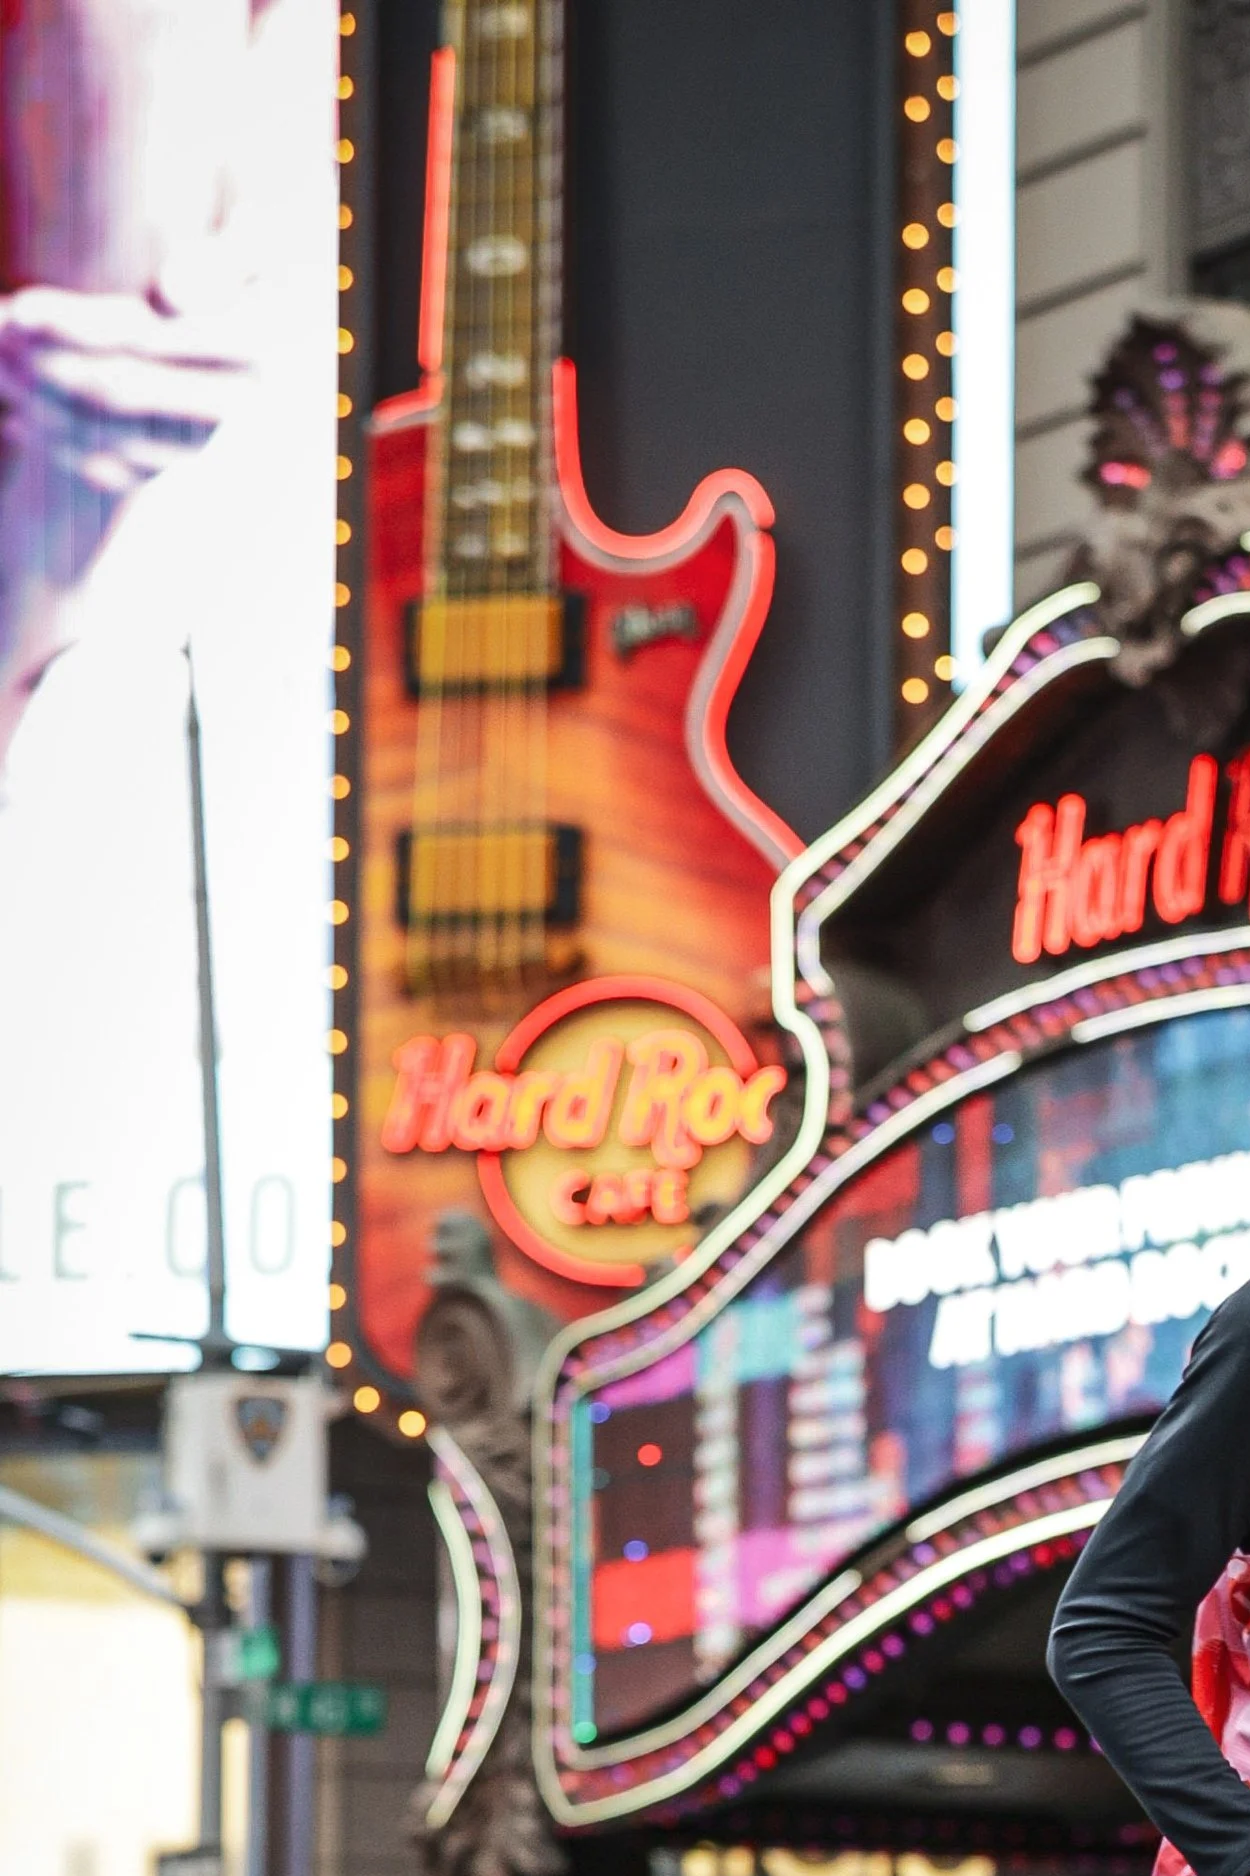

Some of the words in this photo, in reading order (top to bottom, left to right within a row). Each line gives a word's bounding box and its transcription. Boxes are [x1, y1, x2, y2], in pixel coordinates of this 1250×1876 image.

[1012, 754, 1218, 963] Hard
[381, 1033, 625, 1153] Hard
[618, 1028, 788, 1169] Roc
